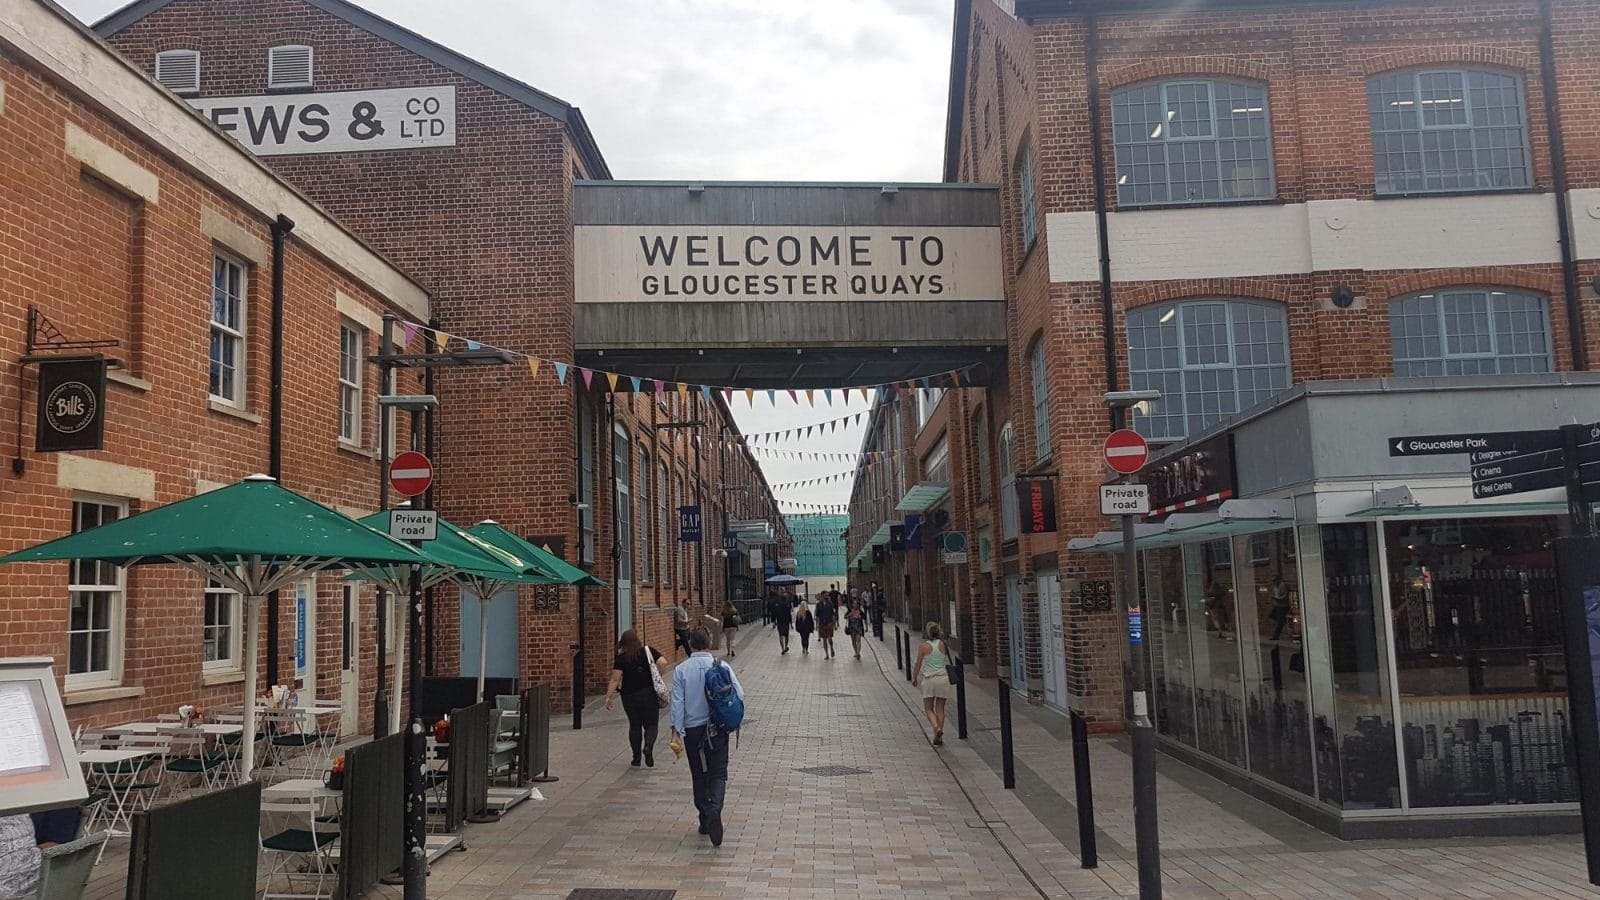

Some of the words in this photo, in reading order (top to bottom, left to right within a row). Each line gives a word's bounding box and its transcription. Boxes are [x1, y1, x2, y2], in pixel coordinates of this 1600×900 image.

[406, 97, 440, 116] CO
[198, 103, 330, 146] EWS
[347, 100, 385, 141] &
[400, 118, 445, 138] LTD
[639, 235, 873, 267] WELCOME
[891, 235, 945, 267] TO
[641, 274, 838, 296] GLOUCESTER
[850, 273, 944, 296] QUAYS
[56, 395, 85, 417] Bill's
[1409, 440, 1464, 451] Gloucester
[1465, 437, 1488, 448] Park
[1480, 466, 1502, 477] Cinema
[1105, 489, 1144, 499] Private
[1031, 486, 1045, 532] FRIDAYS
[1112, 500, 1138, 509] road
[395, 514, 433, 524] Private
[682, 513, 700, 528] GAP
[401, 526, 425, 535] road
[723, 537, 737, 547] GAP
